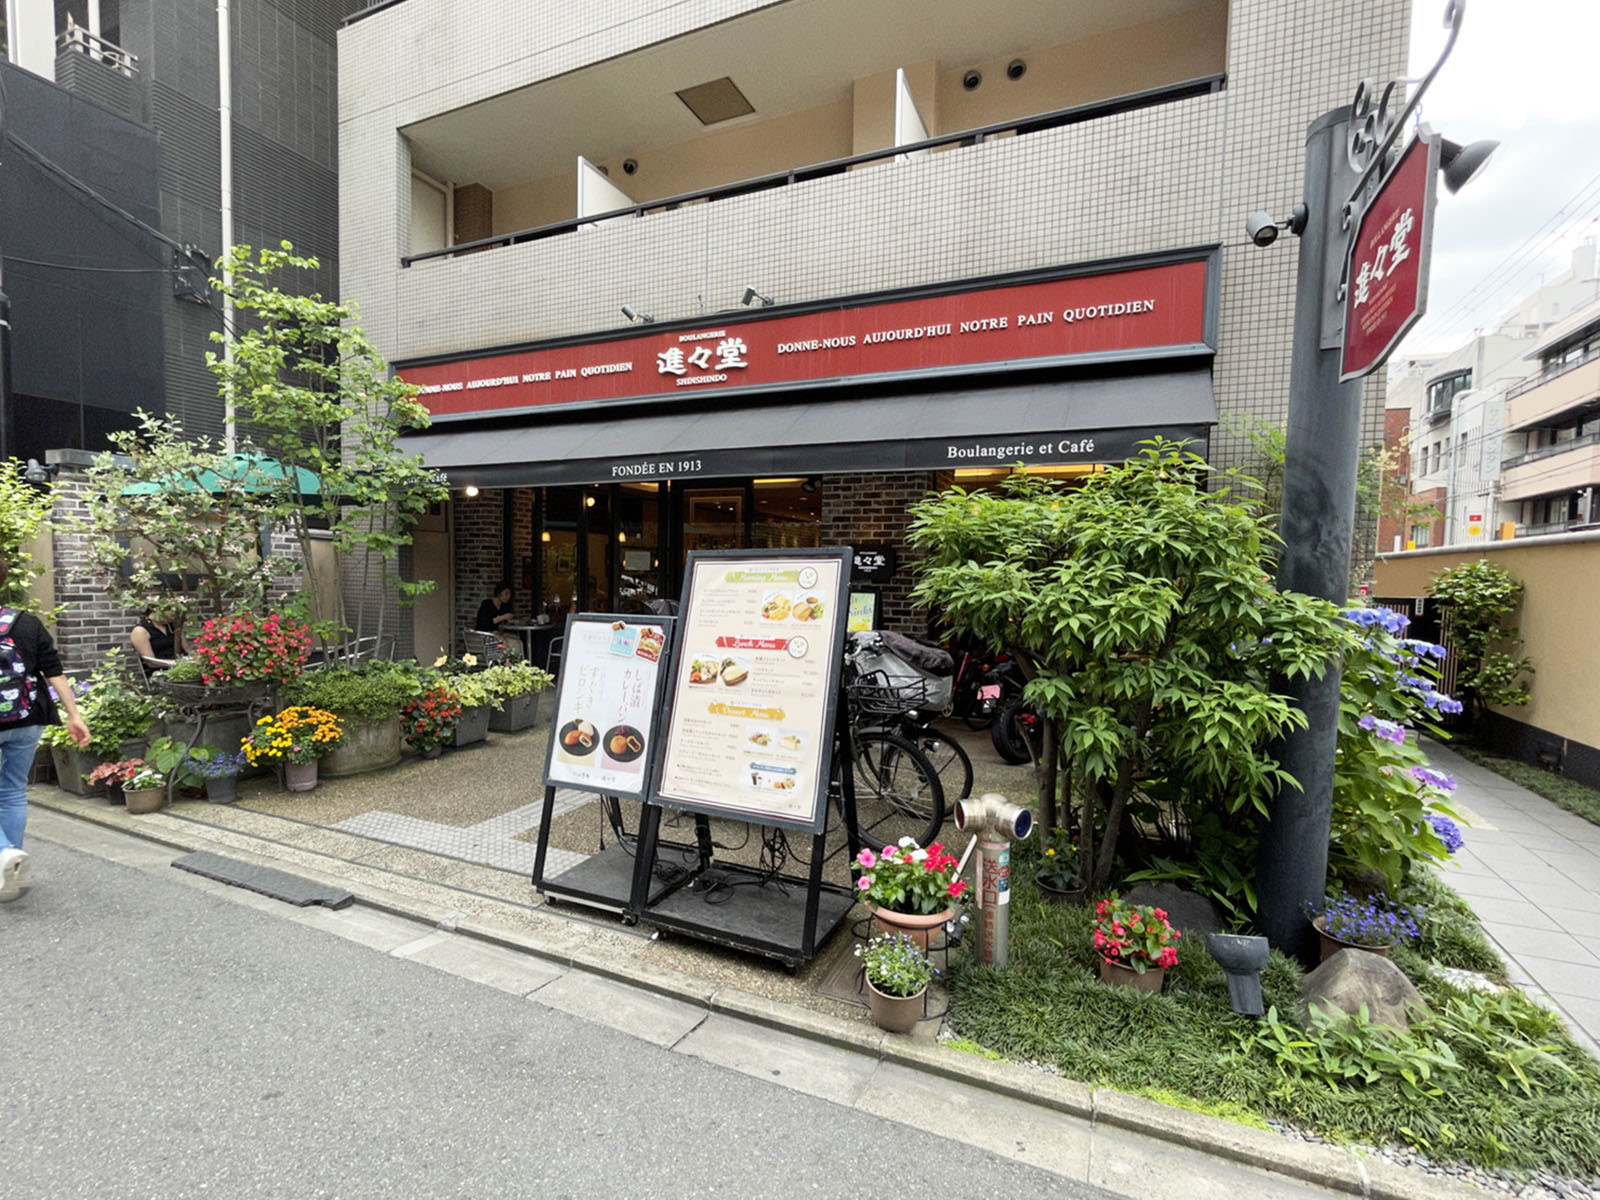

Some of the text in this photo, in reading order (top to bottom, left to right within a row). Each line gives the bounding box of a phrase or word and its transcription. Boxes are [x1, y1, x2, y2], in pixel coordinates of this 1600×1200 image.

[679, 330, 726, 342] BOULANGERIE
[777, 299, 1155, 354] DONNE-NOUS AUJOURD'HUI NOTRE PAIN QUOTIDIEN
[656, 338, 748, 375] 進々堂
[522, 372, 551, 383] NOTRE
[555, 369, 577, 379] PAIN
[581, 362, 632, 377] QUOTIDIEN
[676, 374, 727, 386] SHINSHINDO
[947, 439, 1095, 460] Boulangerie et Café
[612, 460, 702, 477] FONDÉE EN 1913
